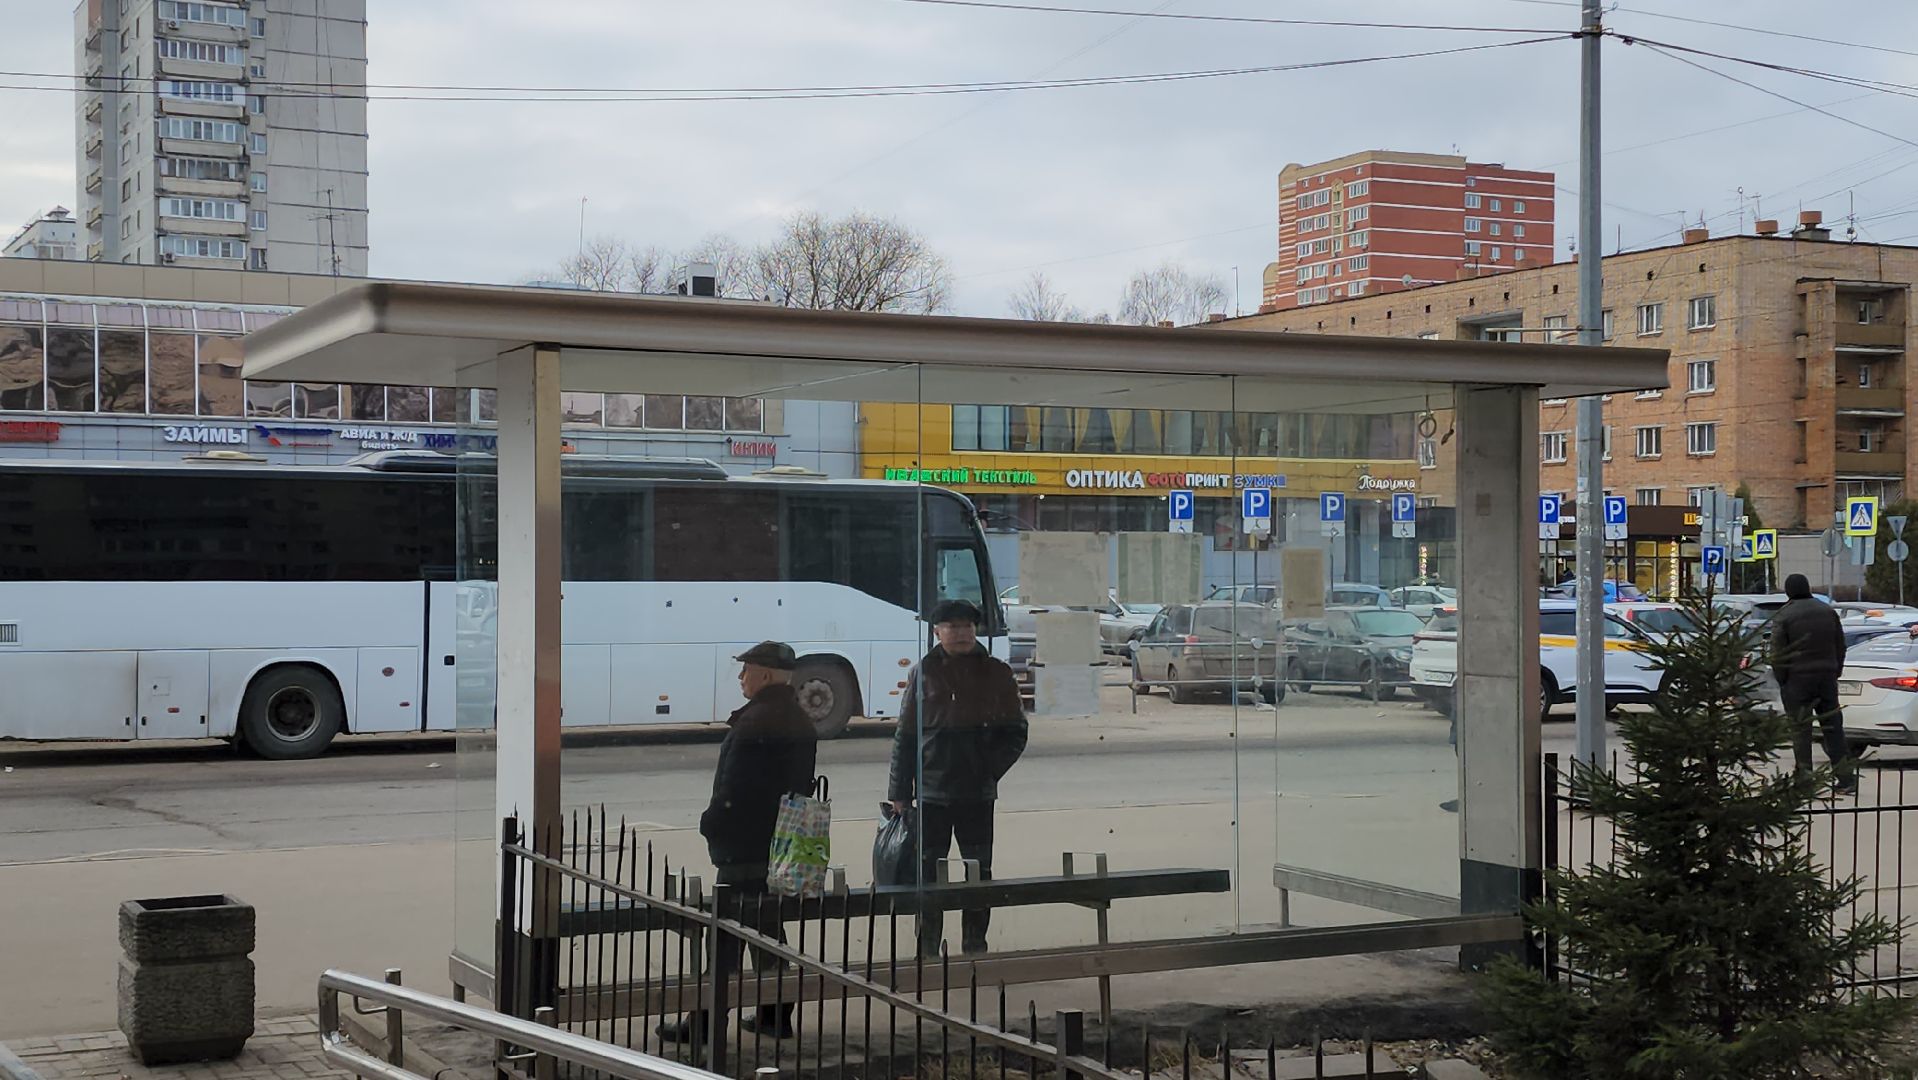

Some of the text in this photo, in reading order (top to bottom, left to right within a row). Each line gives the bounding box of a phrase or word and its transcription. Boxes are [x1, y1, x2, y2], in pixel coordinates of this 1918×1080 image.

[164, 425, 248, 444] ЗАЙМЫ
[340, 429, 377, 440] АВИА
[974, 469, 1037, 485] ТЕКСТИЛЬ
[1066, 470, 1145, 488] ОПТИКА
